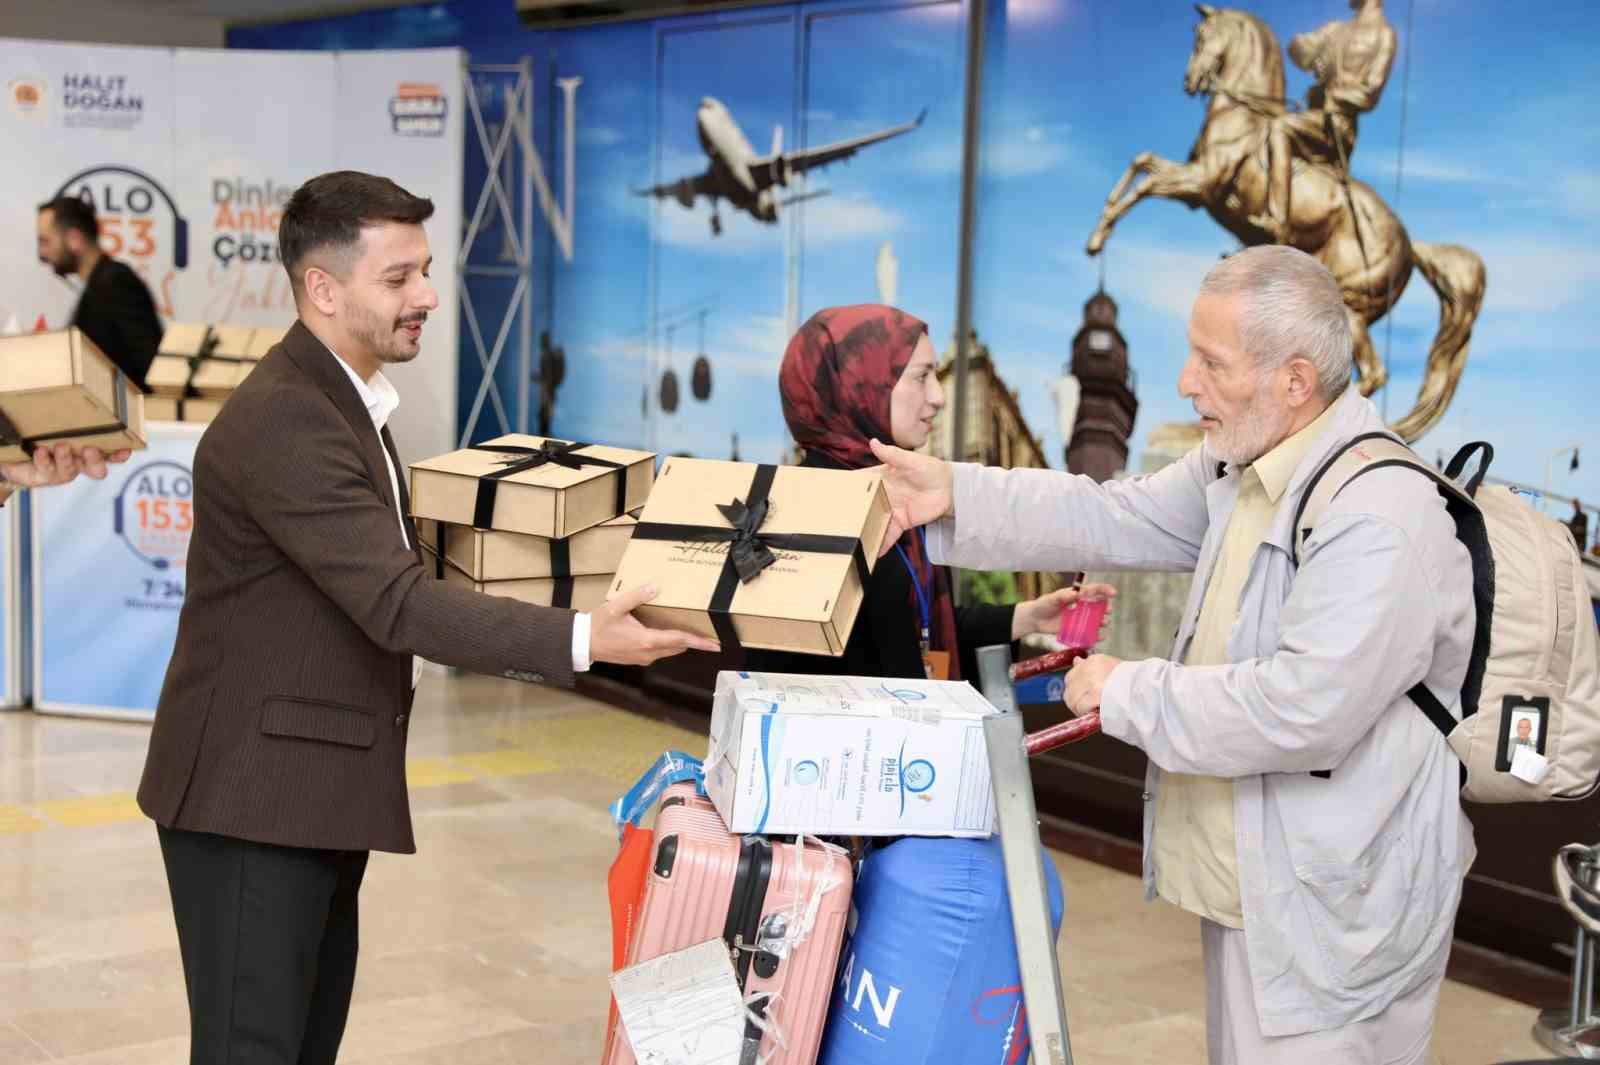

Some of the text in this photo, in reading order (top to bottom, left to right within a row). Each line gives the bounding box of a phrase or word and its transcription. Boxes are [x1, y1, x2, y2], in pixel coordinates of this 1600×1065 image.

[78, 182, 153, 214] ALO
[212, 178, 290, 206] Dinle
[96, 218, 156, 257] 53
[213, 234, 282, 268] Çöz
[137, 474, 192, 497] ALO
[136, 499, 192, 531] 153
[840, 952, 903, 1029] AN
